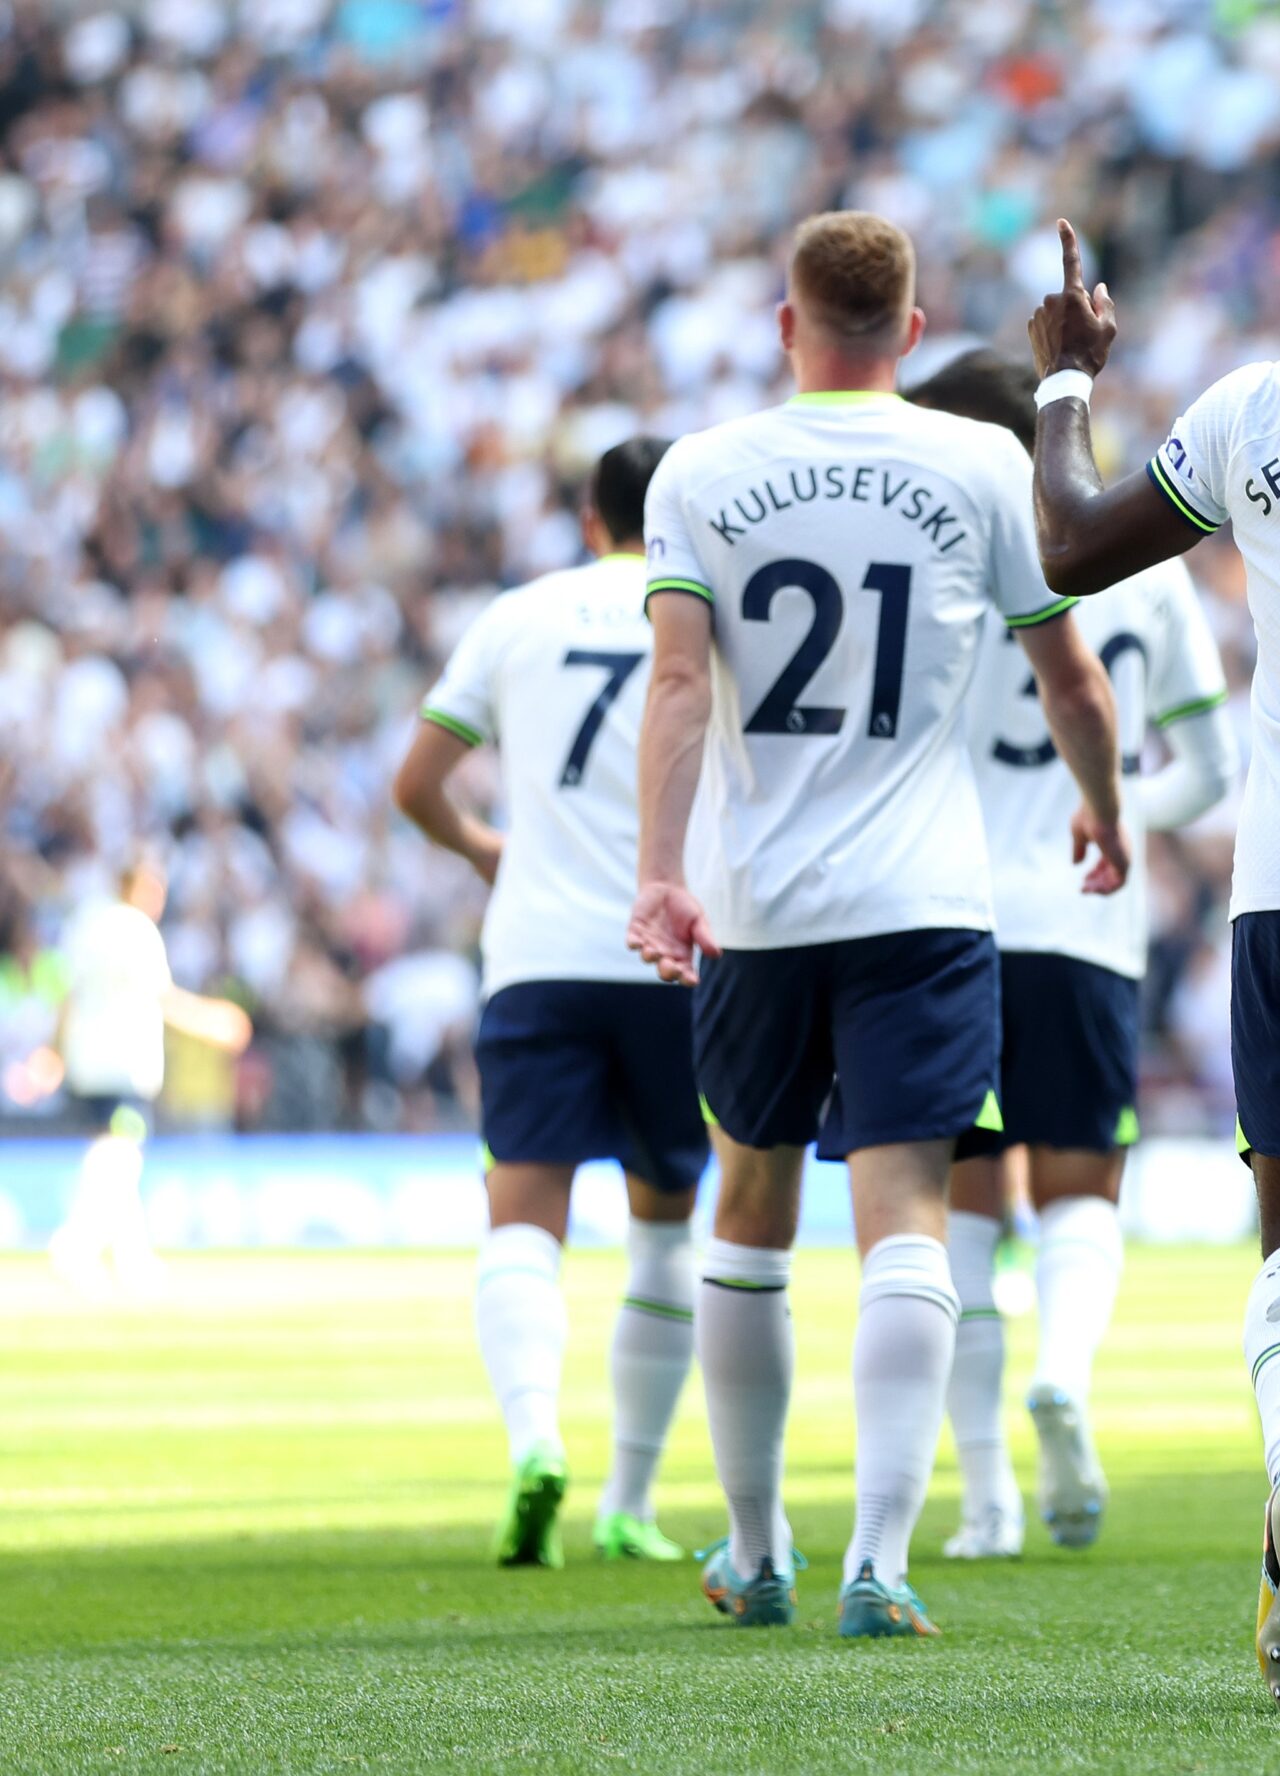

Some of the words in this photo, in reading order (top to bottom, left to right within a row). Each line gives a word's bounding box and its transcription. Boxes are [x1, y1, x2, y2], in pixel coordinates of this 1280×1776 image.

[709, 466, 967, 553] KULUSEVSKI
[740, 557, 914, 740] 21
[559, 650, 646, 788] 7
